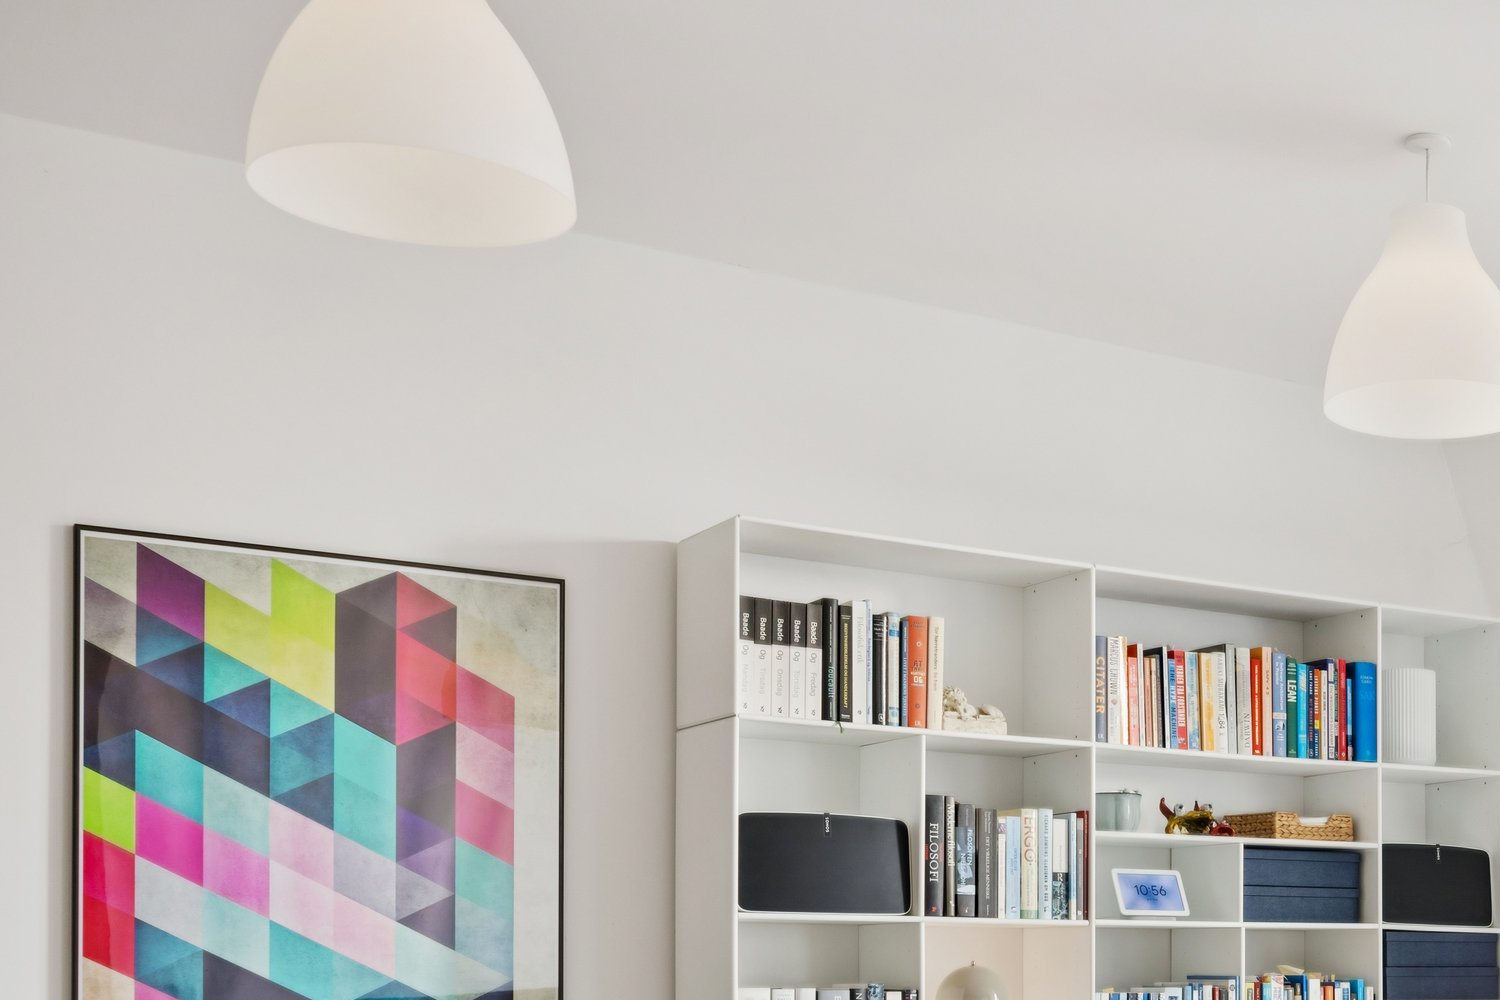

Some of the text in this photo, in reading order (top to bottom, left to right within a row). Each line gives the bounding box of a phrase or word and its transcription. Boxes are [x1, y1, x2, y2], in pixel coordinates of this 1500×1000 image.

[742, 612, 750, 636] Baade
[810, 622, 818, 644] Baade
[1096, 657, 1105, 714] CITATER
[1287, 680, 1296, 702] LEAN
[929, 823, 939, 882] FILOSOFI
[1134, 885, 1167, 897] 10:56
